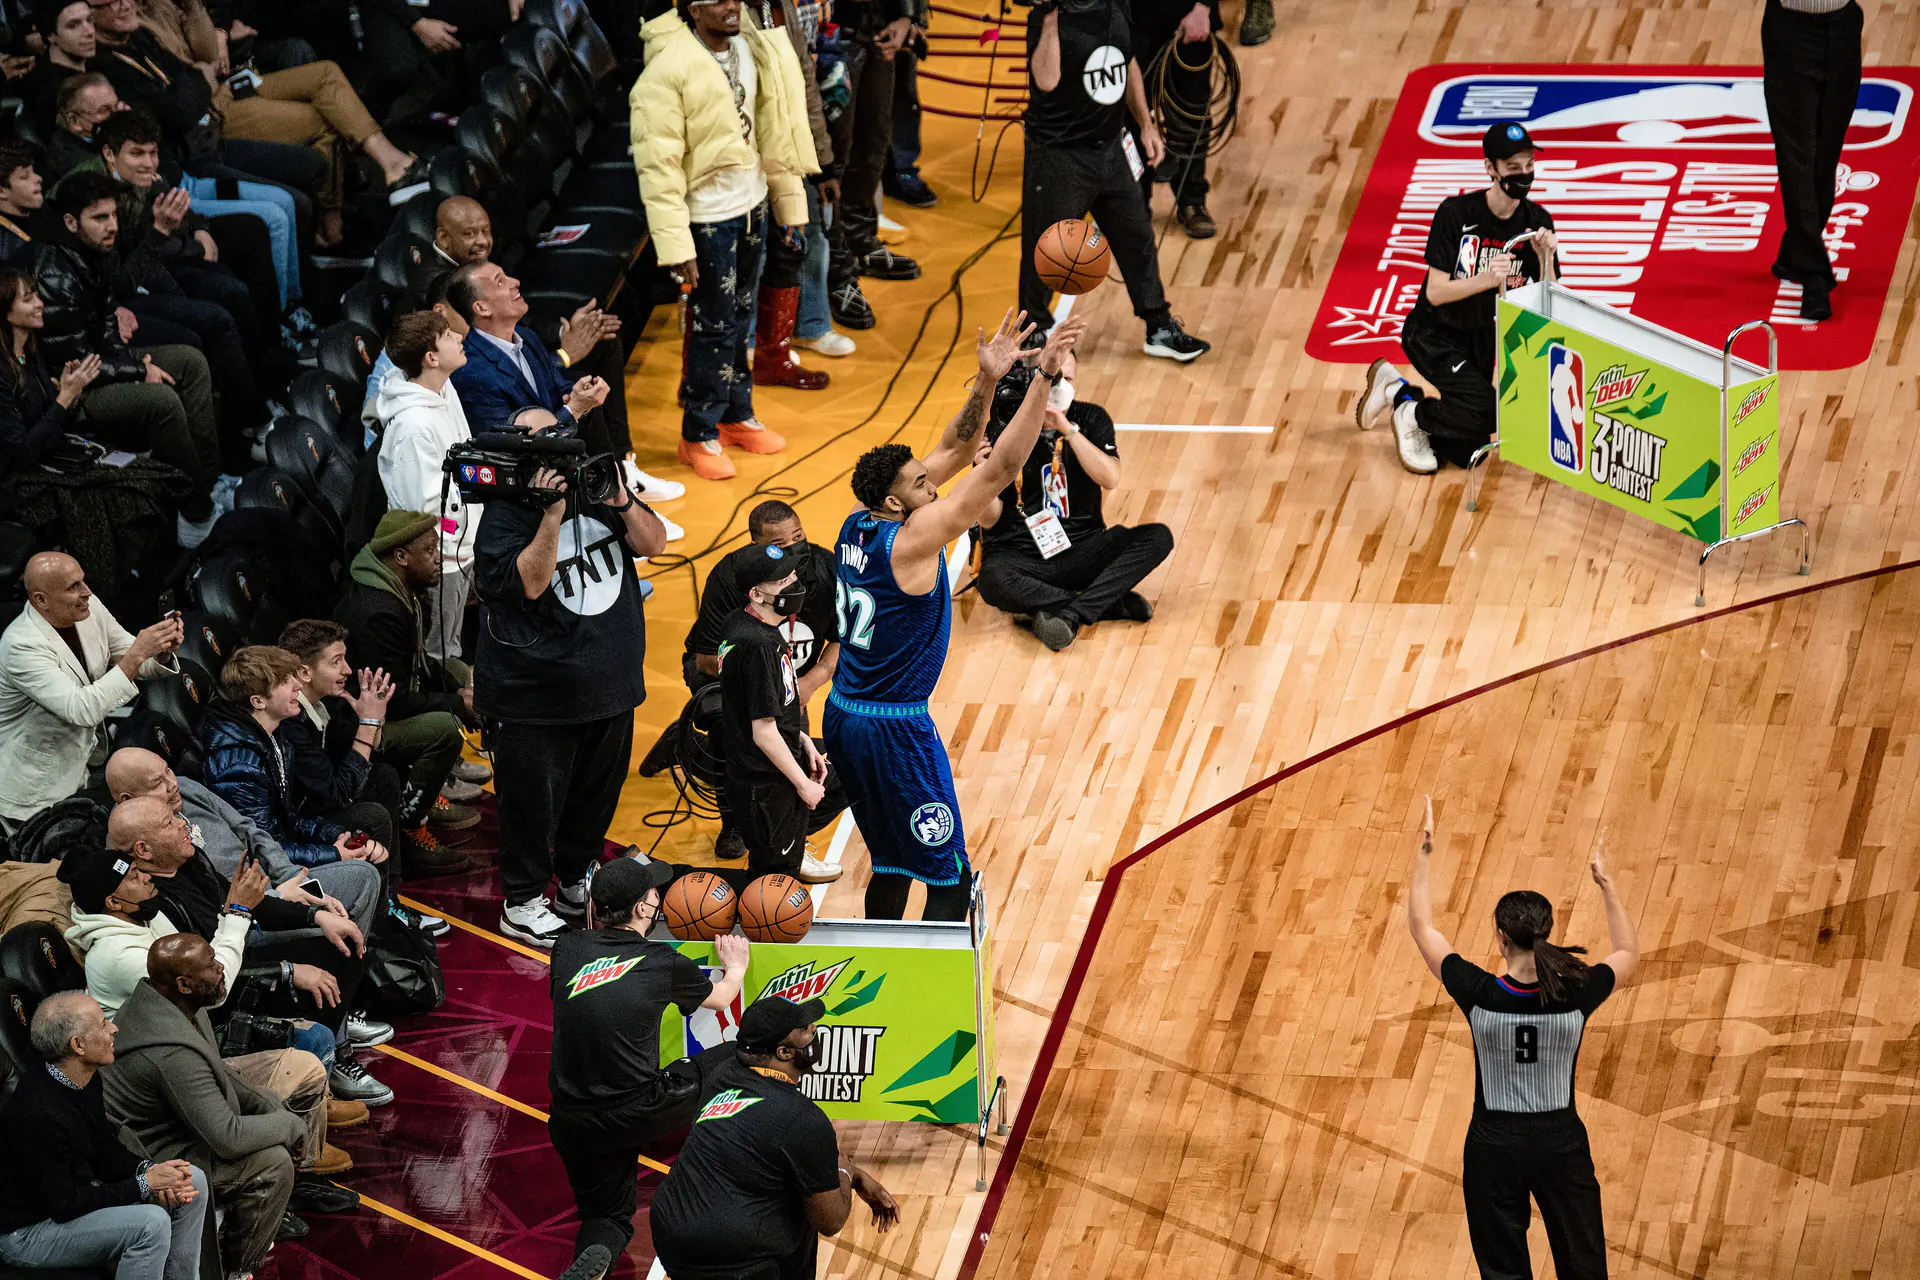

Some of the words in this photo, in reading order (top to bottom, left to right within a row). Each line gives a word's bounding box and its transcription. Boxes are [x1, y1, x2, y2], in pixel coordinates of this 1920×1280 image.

[1083, 62, 1126, 90] TNT
[1457, 85, 1539, 120] NBA
[1526, 160, 1677, 314] SATURD
[1553, 437, 1572, 464] NBA
[1611, 420, 1668, 482] POINT
[481, 472, 493, 480] TNT
[1609, 462, 1654, 502] CONTEST
[555, 532, 618, 599] TNT
[841, 543, 869, 575] TOWNS
[836, 574, 876, 650] 32
[577, 960, 614, 979] Mtn
[763, 967, 809, 999] Mtn
[811, 1026, 883, 1075] OINT
[1515, 1025, 1538, 1064] 9
[797, 1074, 865, 1101] ONTEST
